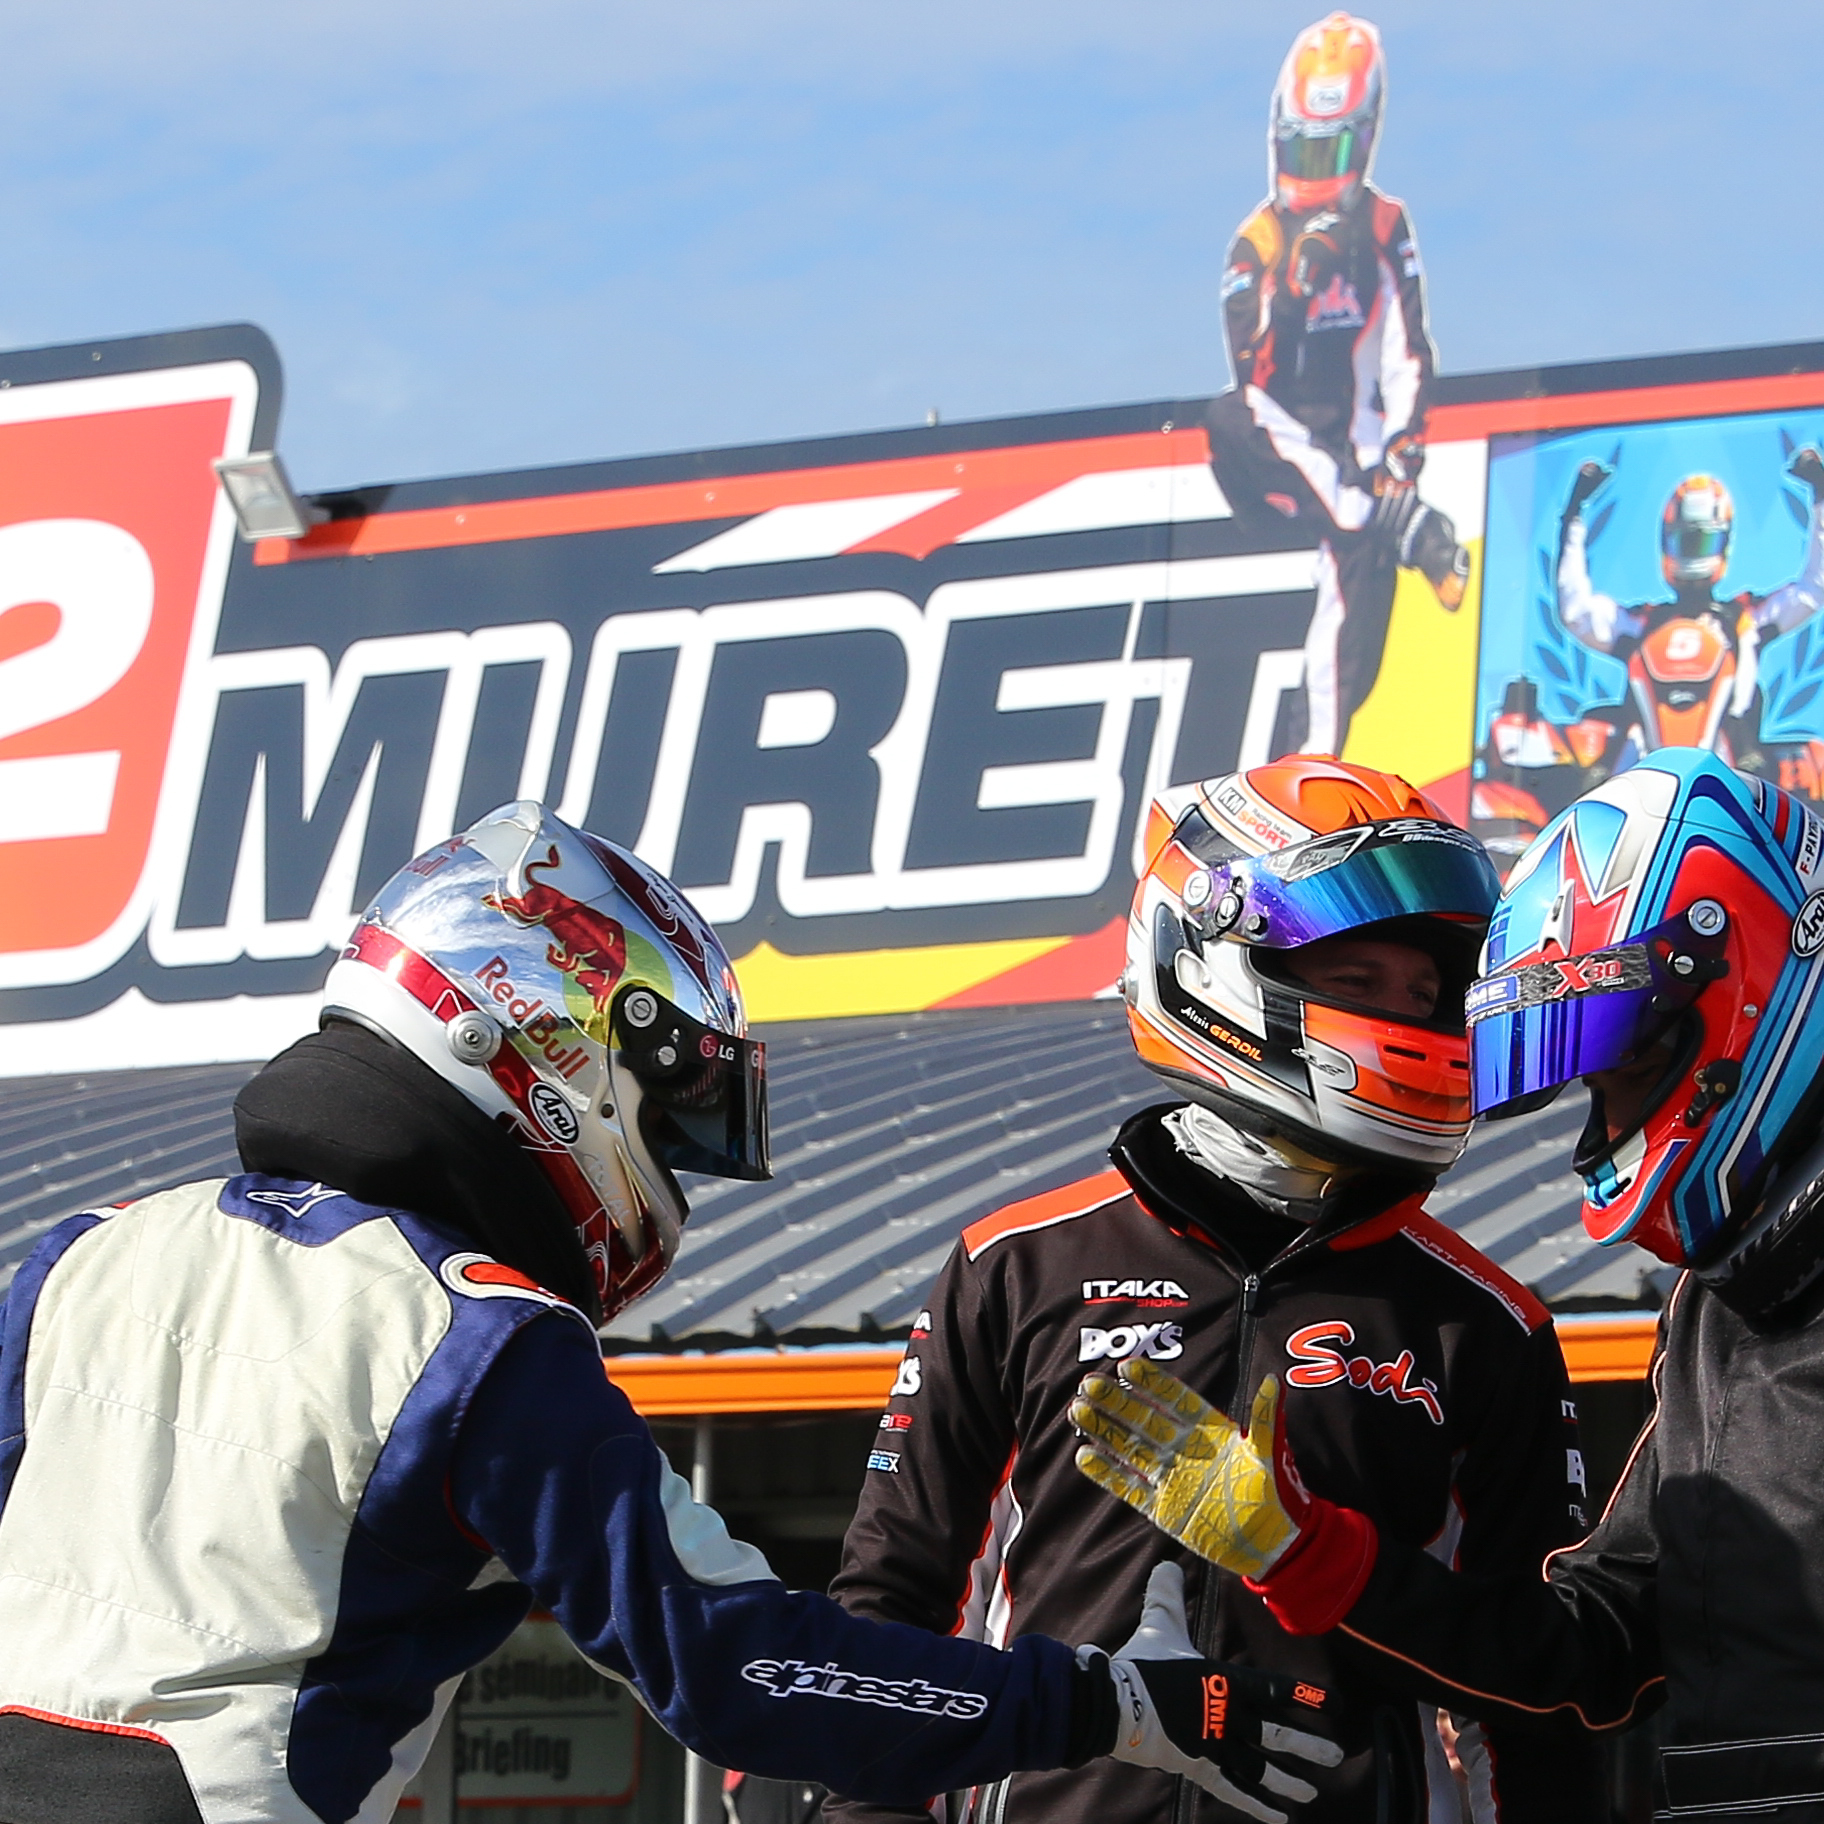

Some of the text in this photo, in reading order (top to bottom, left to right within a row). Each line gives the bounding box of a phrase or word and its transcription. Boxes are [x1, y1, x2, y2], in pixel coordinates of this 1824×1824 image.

[1665, 626, 1702, 661] 5
[1238, 809, 1291, 850] SPORT
[1552, 957, 1623, 997] X30
[1209, 1024, 1263, 1062] GERDIL
[1083, 1280, 1189, 1299] ITAKA
[1402, 1225, 1527, 1320] KART RACING
[1285, 1321, 1445, 1425] Sodi
[741, 1659, 988, 1720] alpinestars
[1206, 1675, 1229, 1739] OMP
[1294, 1684, 1326, 1704] OMP
